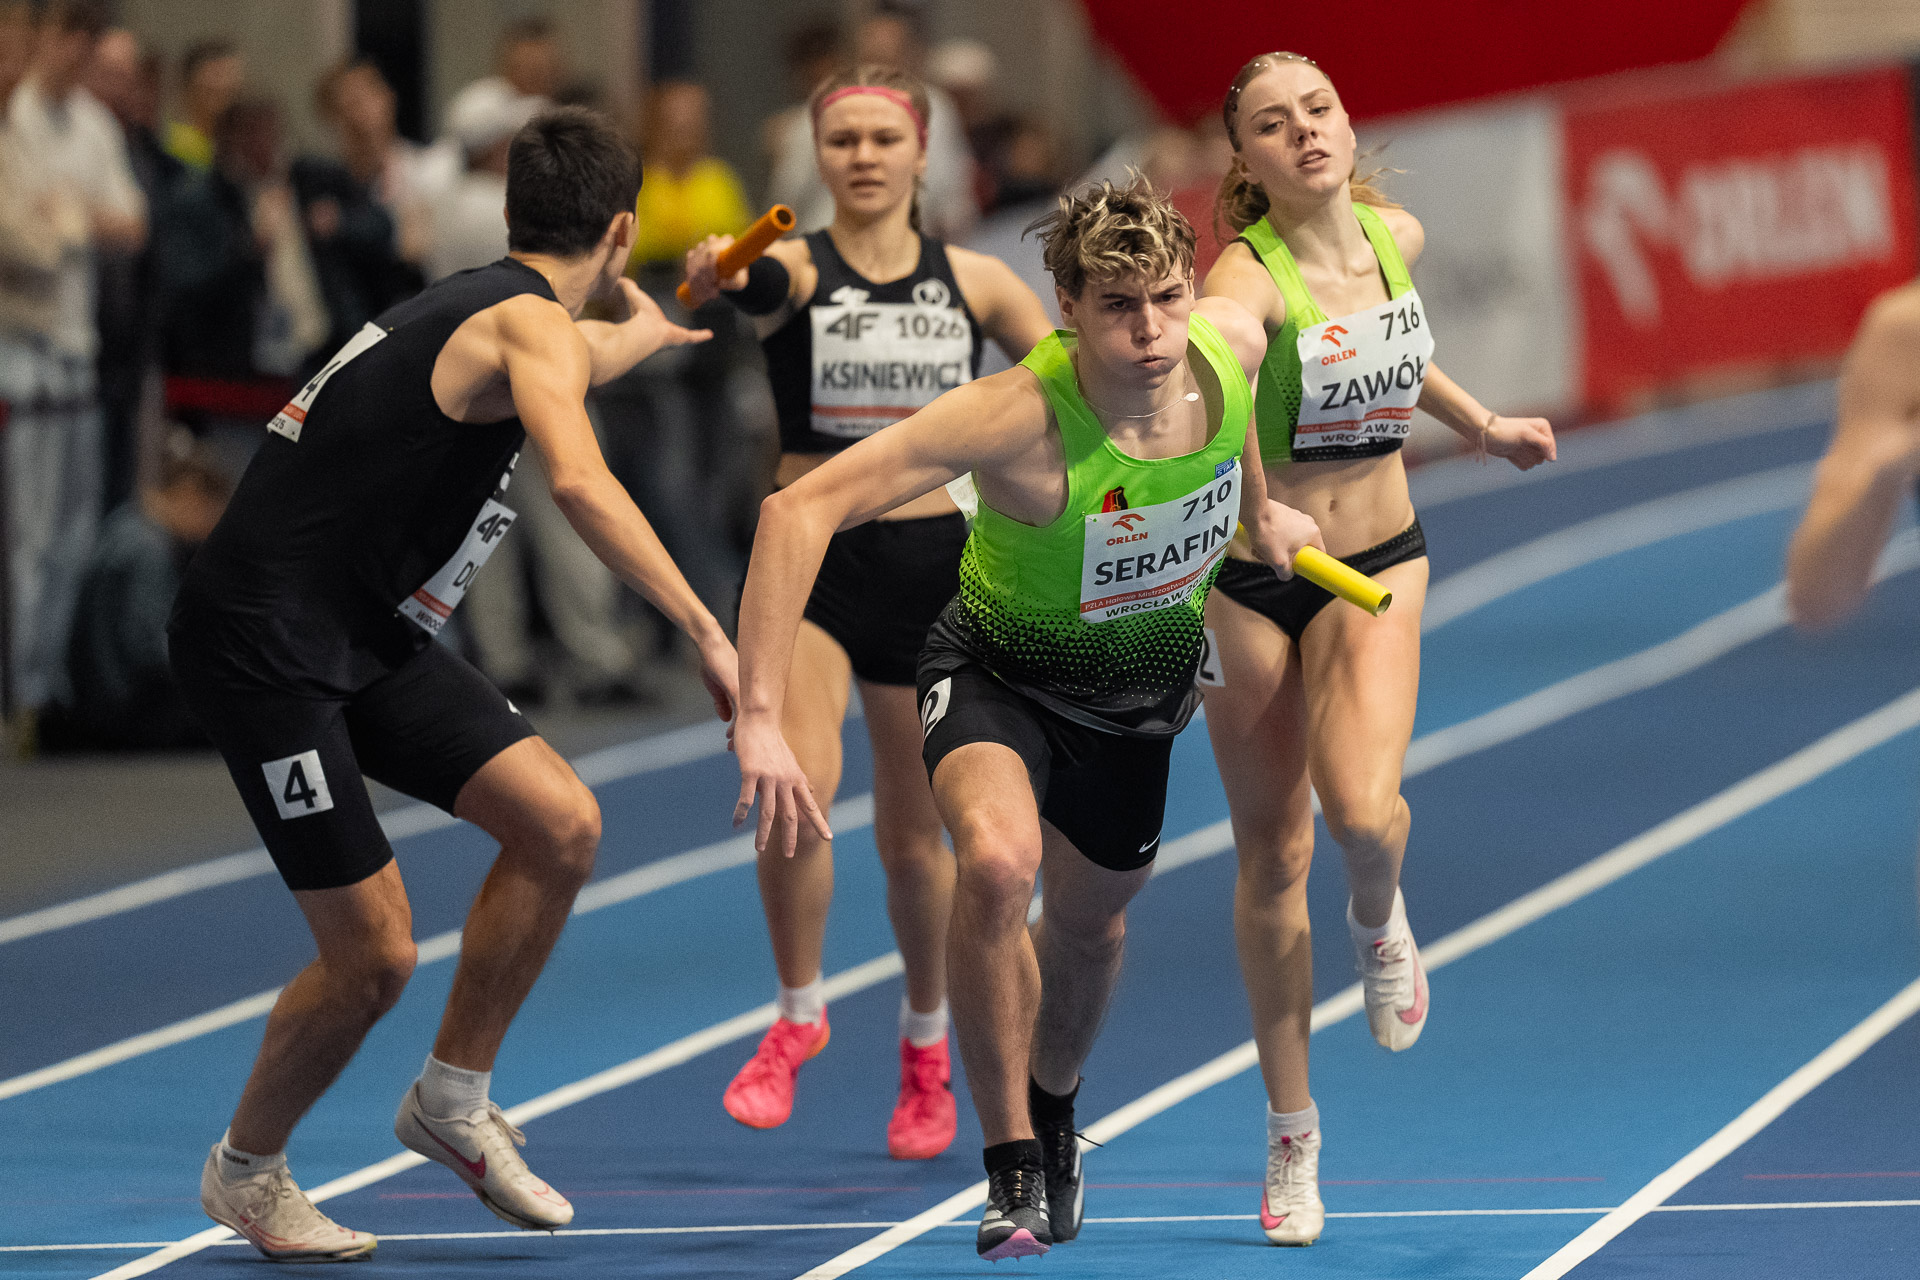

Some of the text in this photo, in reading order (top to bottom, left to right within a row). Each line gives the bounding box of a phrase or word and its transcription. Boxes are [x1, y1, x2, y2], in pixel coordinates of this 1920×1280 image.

[826, 313, 879, 340] 4F
[897, 314, 965, 339] 1026
[1379, 302, 1420, 341] 716
[1321, 348, 1357, 366] ORLEN
[1320, 353, 1425, 411] ZAWÓŁ
[1183, 479, 1232, 523] 710
[1094, 514, 1230, 586] SERAFIN
[1106, 532, 1148, 546] ORLEN
[1085, 601, 1104, 611] PZLA
[1105, 594, 1136, 606] Halowe
[1138, 581, 1184, 598] Mistrzostwa
[1105, 590, 1185, 618] WROCŁAW
[284, 760, 318, 809] 4
